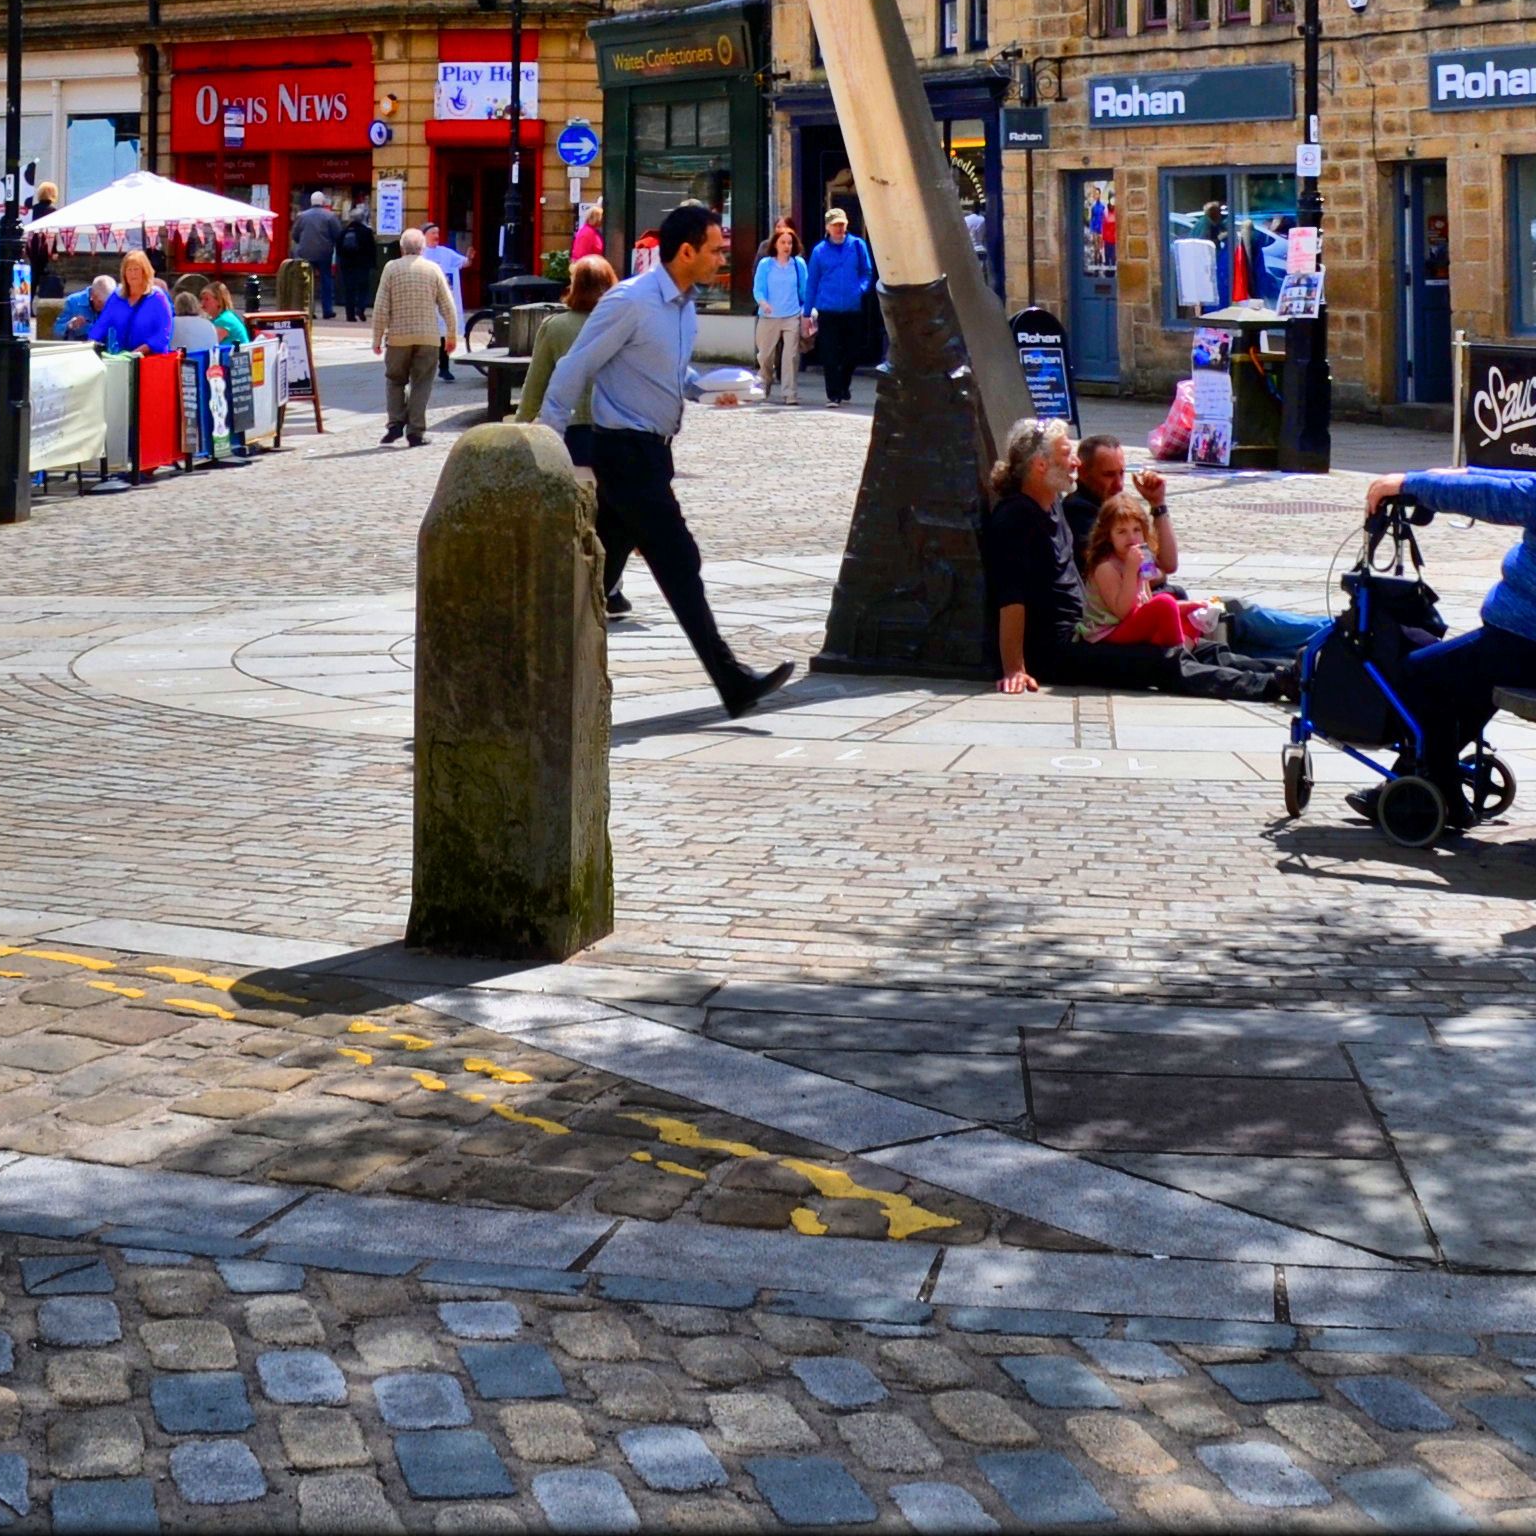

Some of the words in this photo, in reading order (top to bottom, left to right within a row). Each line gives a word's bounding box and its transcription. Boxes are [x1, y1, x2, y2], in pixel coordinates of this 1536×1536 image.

[646, 47, 714, 68] Confectioners
[441, 66, 483, 85] Play
[196, 85, 268, 125] OIS
[1094, 85, 1186, 118] Rohan
[1008, 132, 1043, 142] Rohan
[1017, 332, 1062, 344] Rohan
[1023, 354, 1061, 364] Rohan
